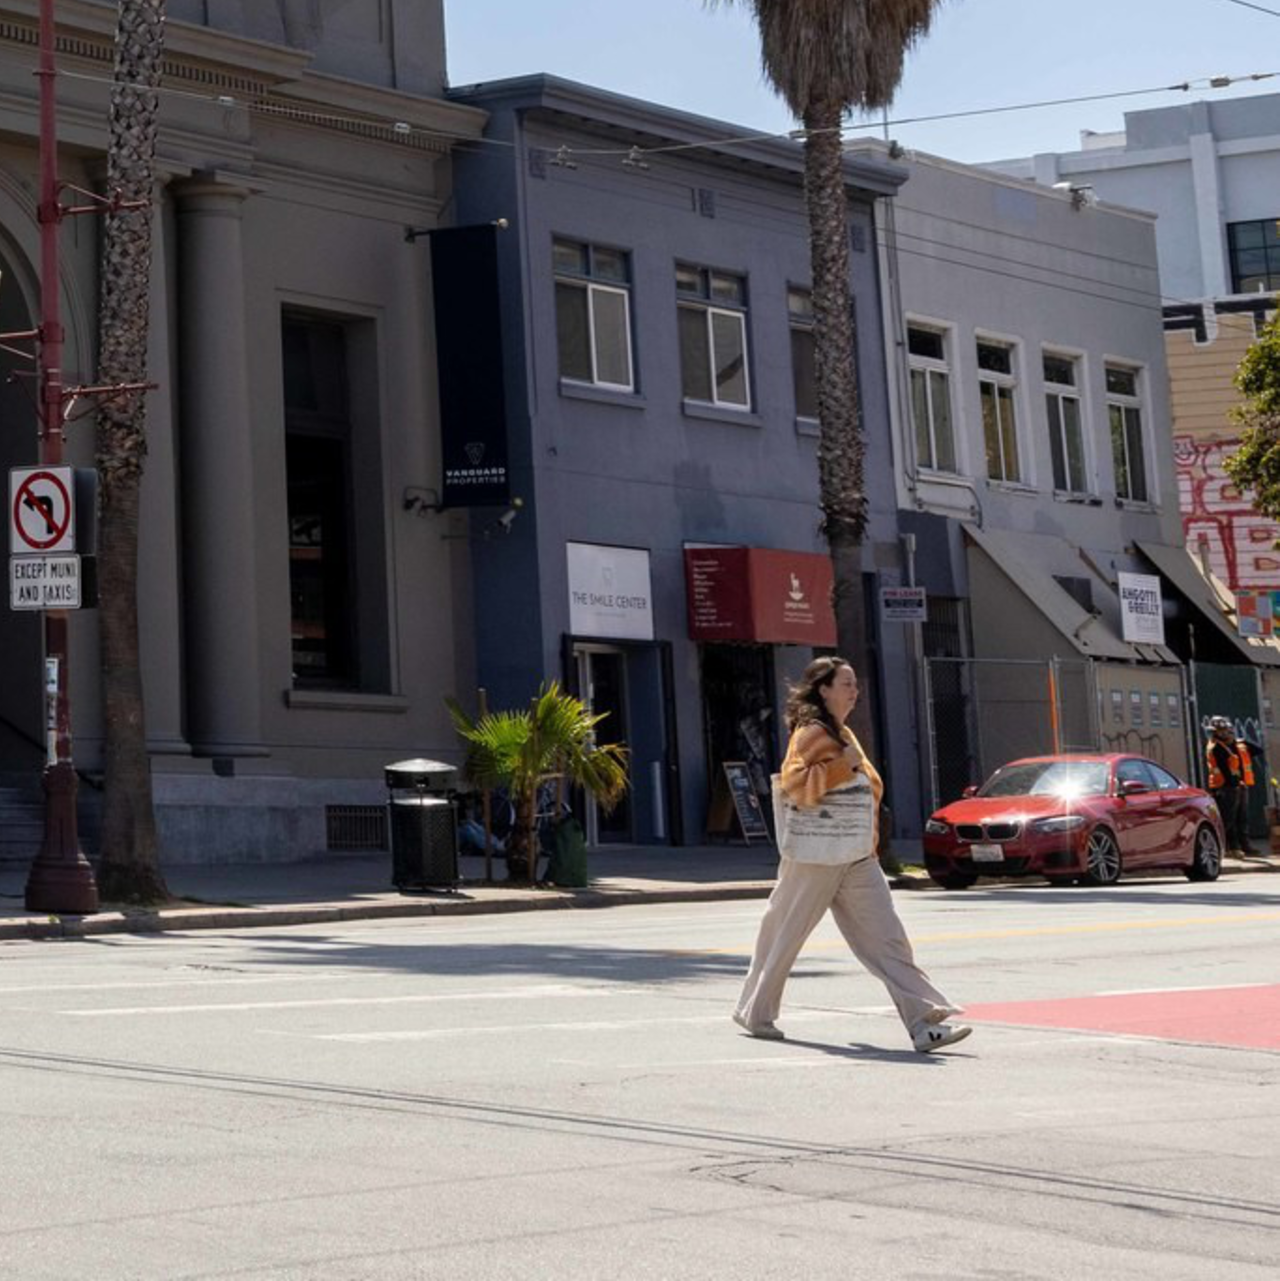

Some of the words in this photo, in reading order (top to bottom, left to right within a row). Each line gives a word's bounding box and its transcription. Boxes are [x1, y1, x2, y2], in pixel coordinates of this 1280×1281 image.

[446, 467, 505, 477] VANGUARD
[446, 476, 505, 485] PROPERTIES
[15, 563, 47, 579] EXCEPT
[50, 563, 76, 579] MUNI
[19, 586, 39, 601] AND
[42, 585, 72, 601] TAXIS
[572, 591, 588, 606] THE
[590, 593, 614, 607] SMILE
[616, 595, 647, 609] CENTER
